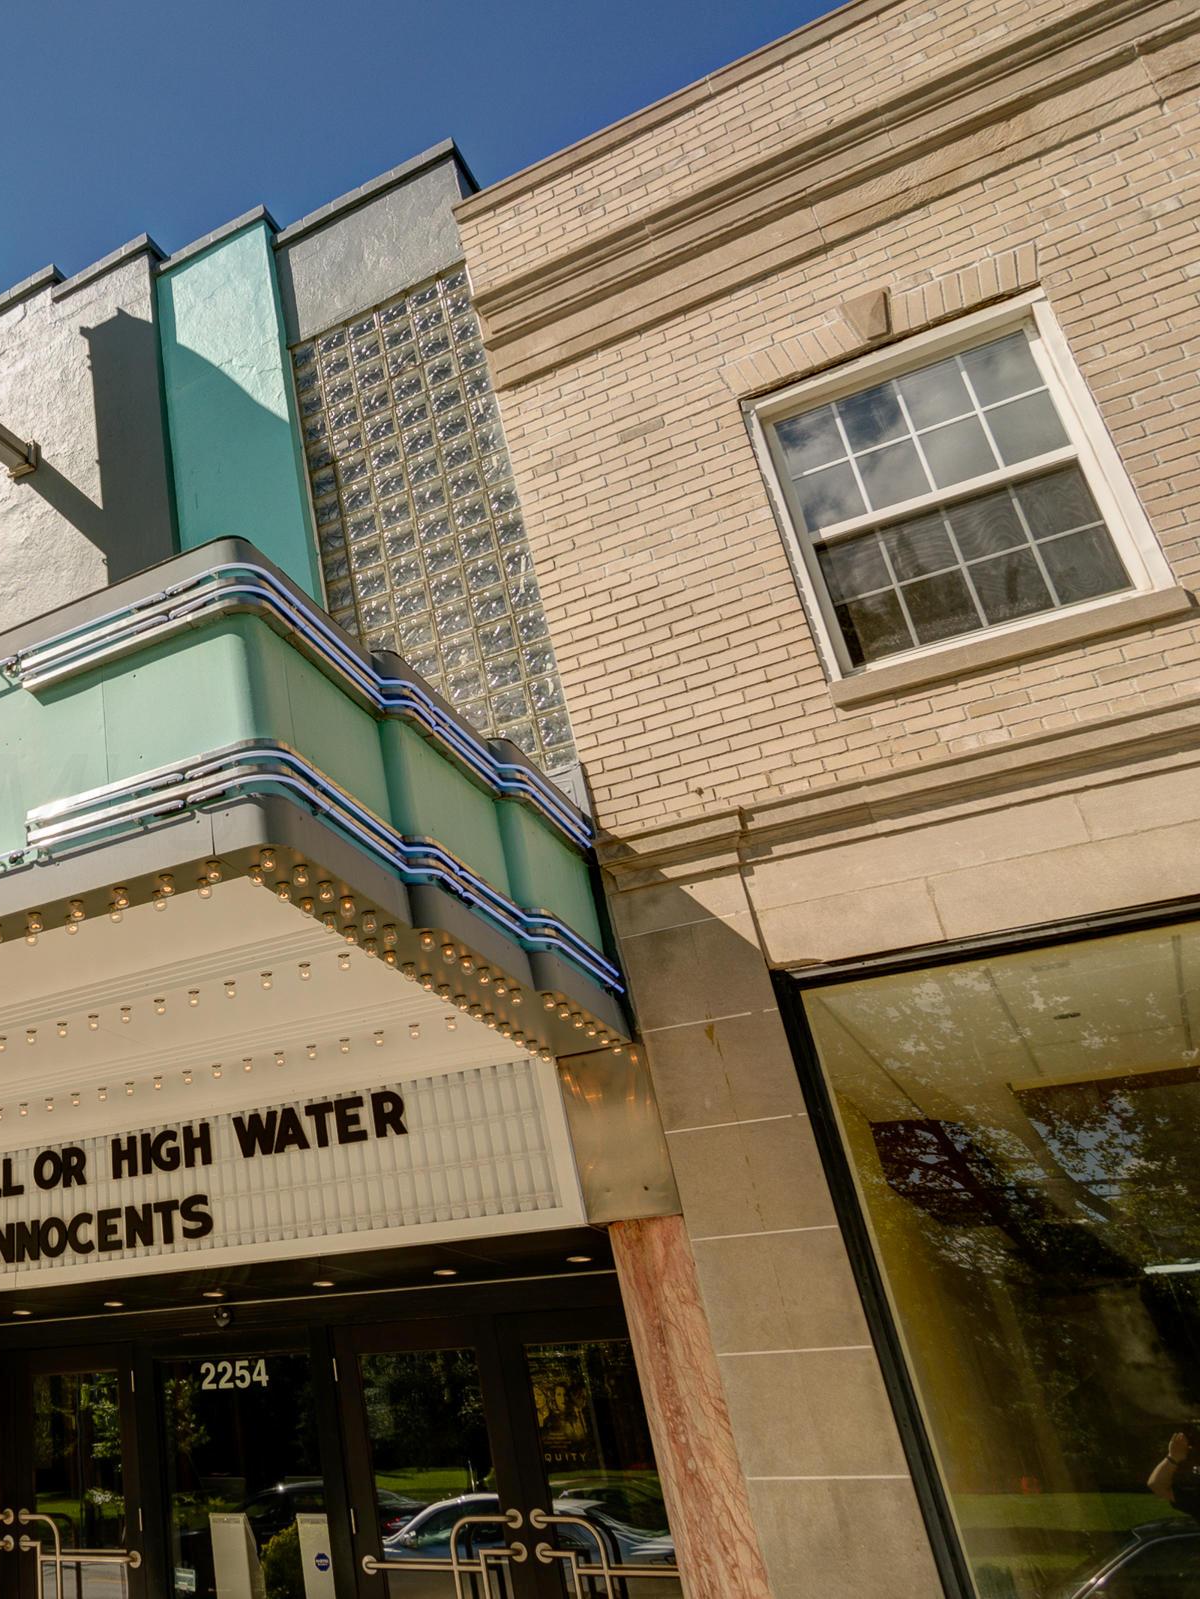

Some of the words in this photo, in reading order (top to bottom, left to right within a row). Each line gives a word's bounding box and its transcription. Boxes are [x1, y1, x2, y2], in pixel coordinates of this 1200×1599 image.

[33, 1146, 87, 1191] OR
[111, 1122, 213, 1180] HIGH
[232, 1090, 408, 1158] WATER
[200, 1359, 269, 1390] 2254
